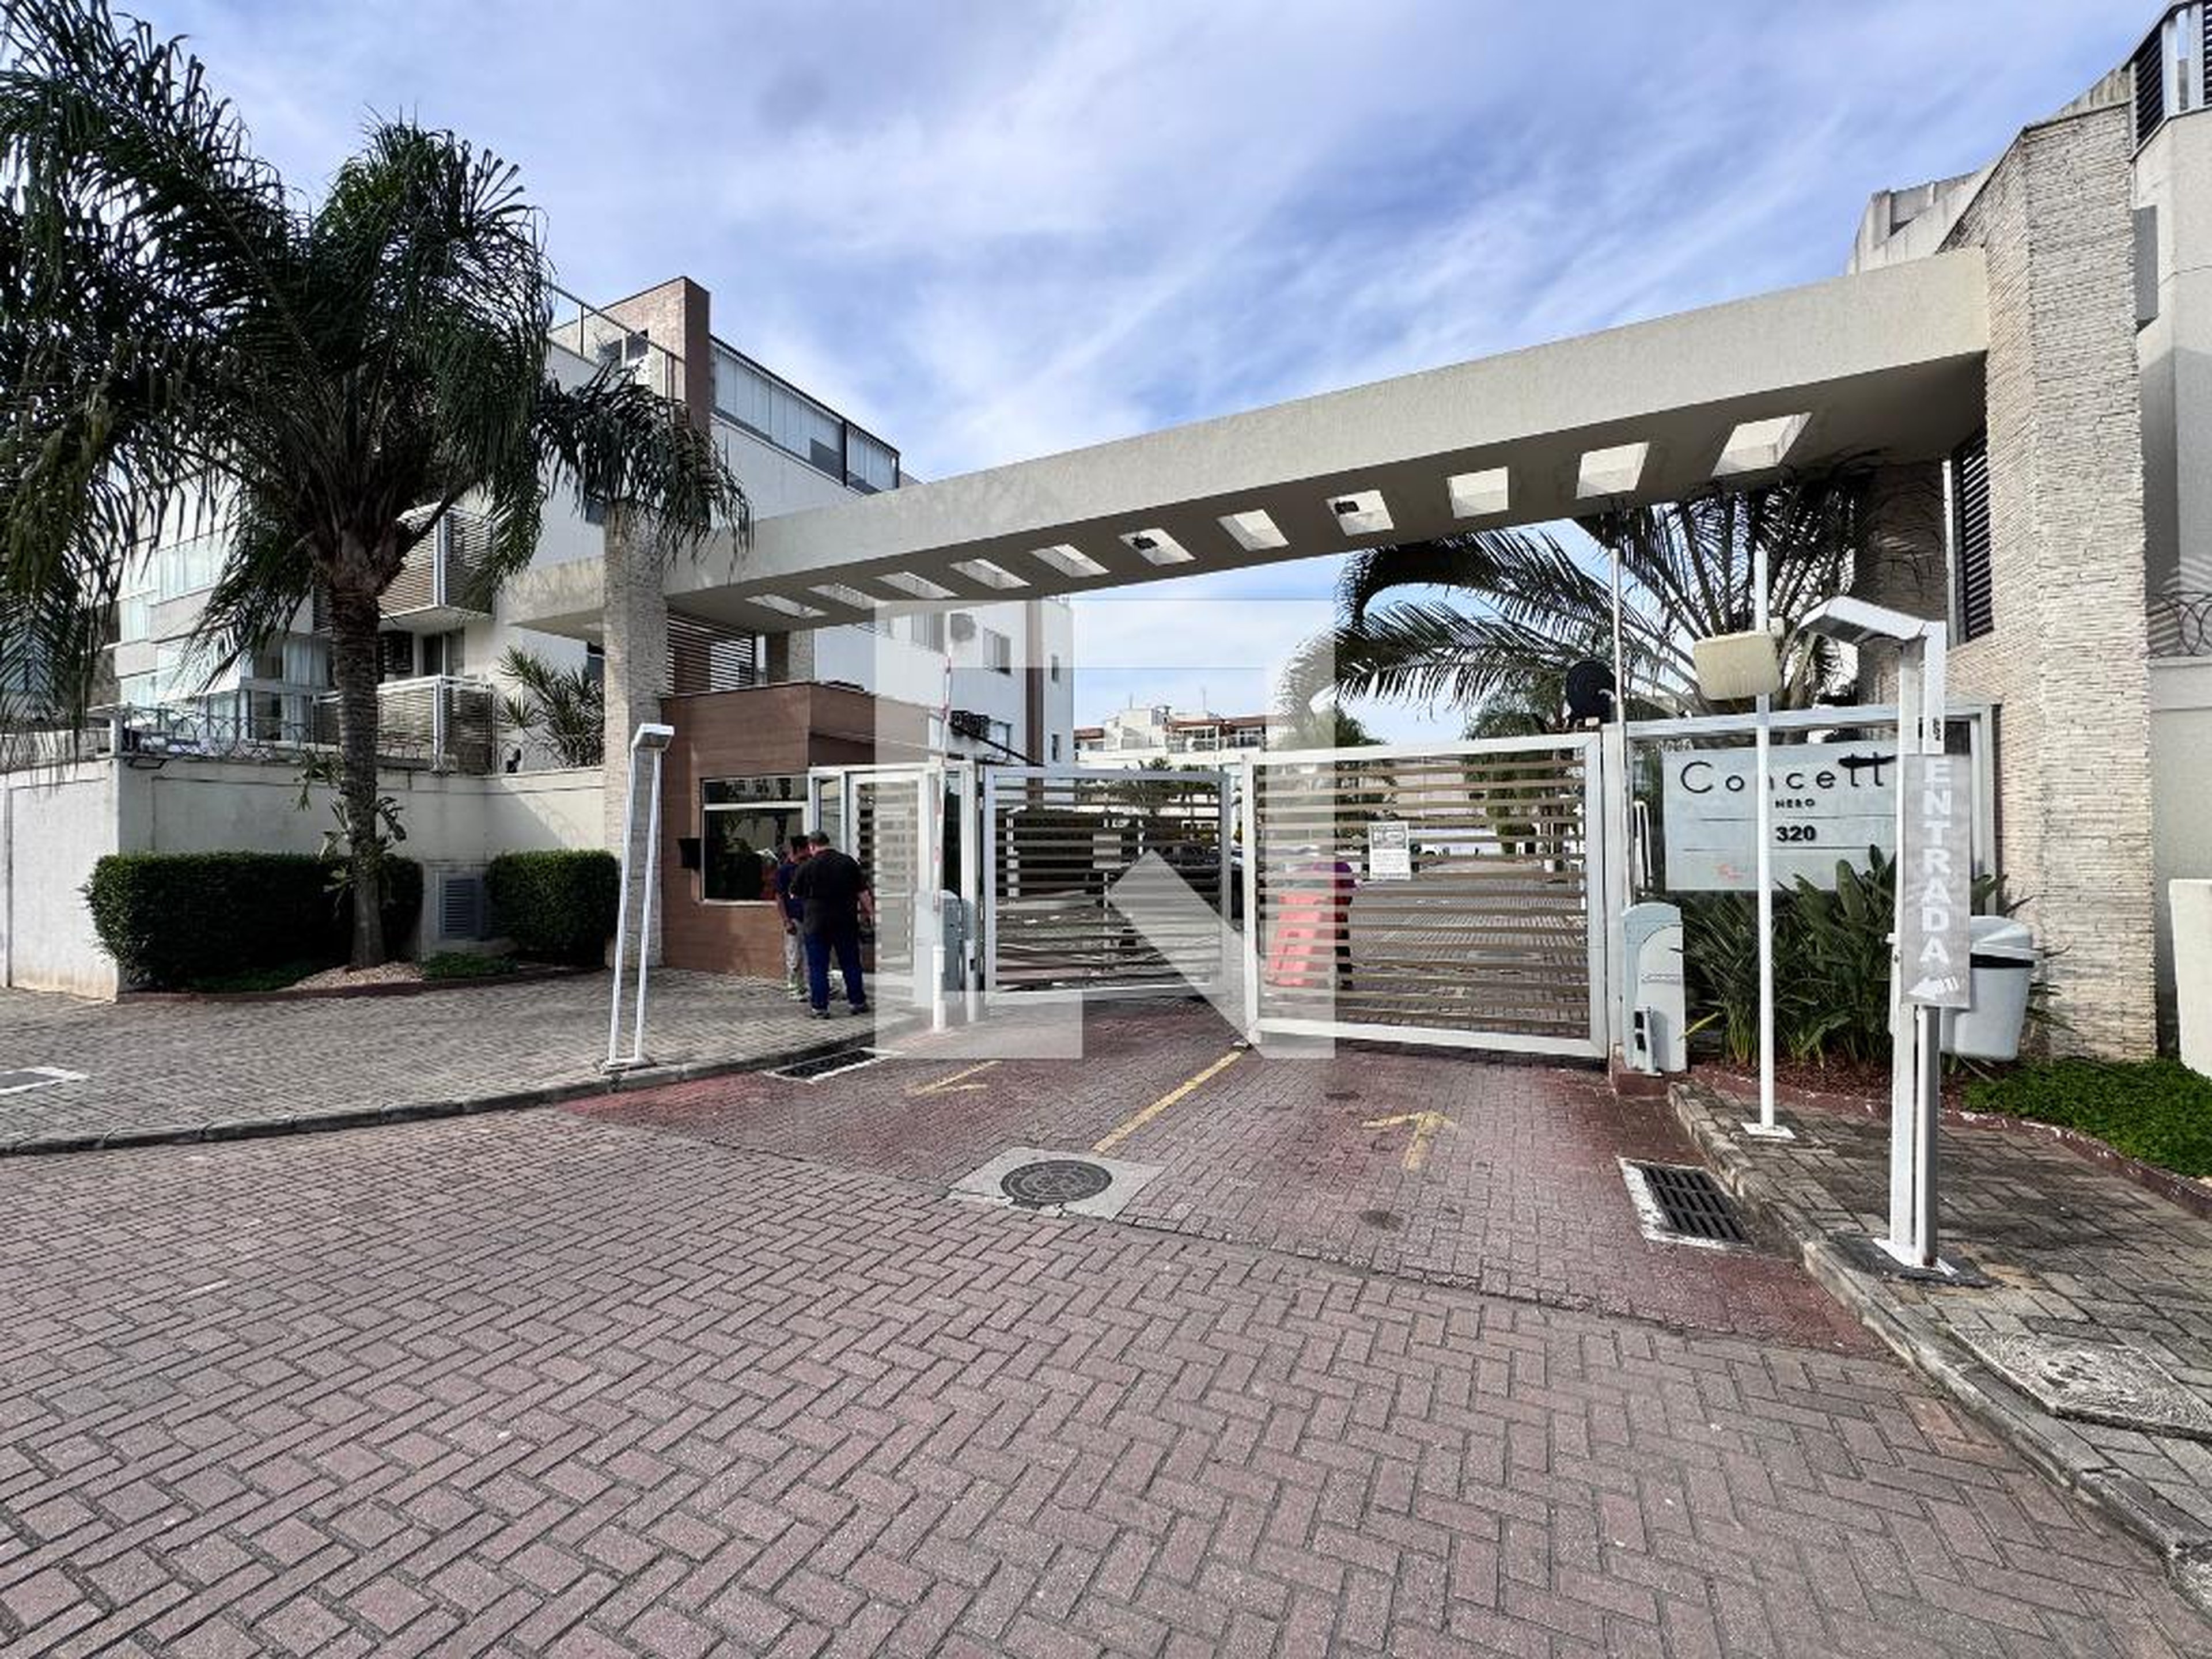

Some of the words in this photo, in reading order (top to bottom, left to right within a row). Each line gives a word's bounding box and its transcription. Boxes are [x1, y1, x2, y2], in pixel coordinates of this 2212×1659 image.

[1680, 752, 1897, 793] Cocett
[1776, 825, 1816, 842] 320
[1919, 760, 1952, 963] ENTRADA
